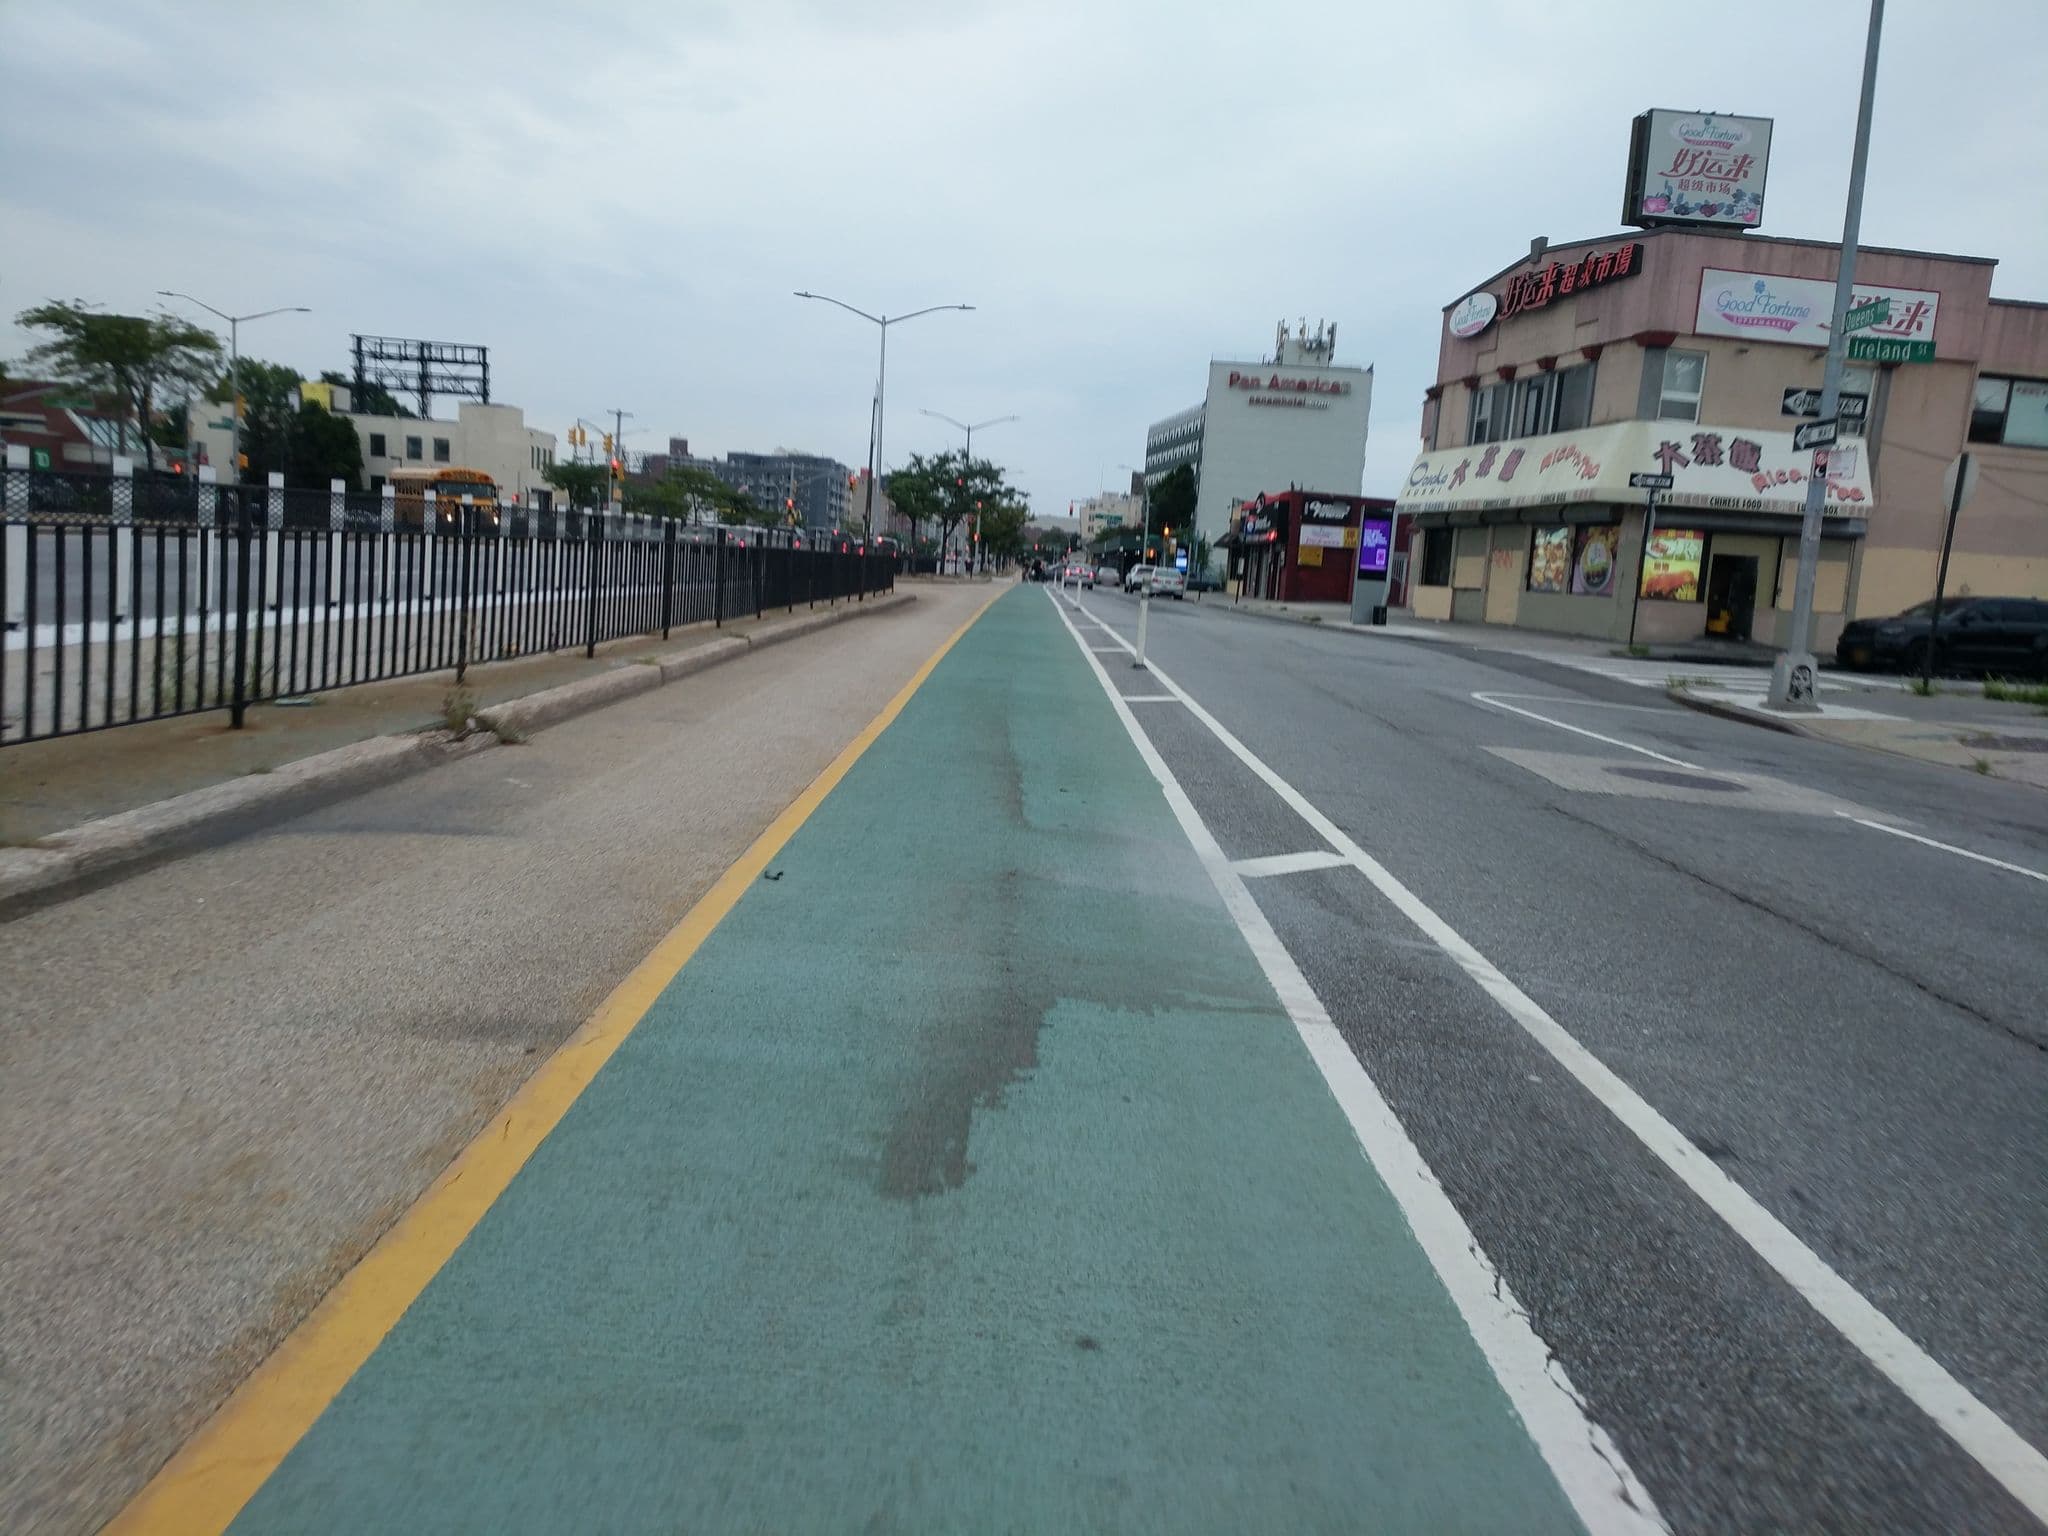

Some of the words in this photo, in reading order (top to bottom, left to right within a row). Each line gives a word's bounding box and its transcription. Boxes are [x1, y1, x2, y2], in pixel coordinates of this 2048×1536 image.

[1678, 122, 1707, 138] Good
[1716, 289, 1757, 312] Good
[1757, 292, 1811, 318] Fortune
[1845, 306, 1876, 331] Queens
[1854, 340, 1912, 360] Ireland
[1229, 370, 1262, 389] Pan
[1267, 373, 1350, 396] American
[1709, 496, 1740, 508] CHINESE
[1742, 498, 1762, 509] FOOD
[1823, 504, 1839, 515] BOX
